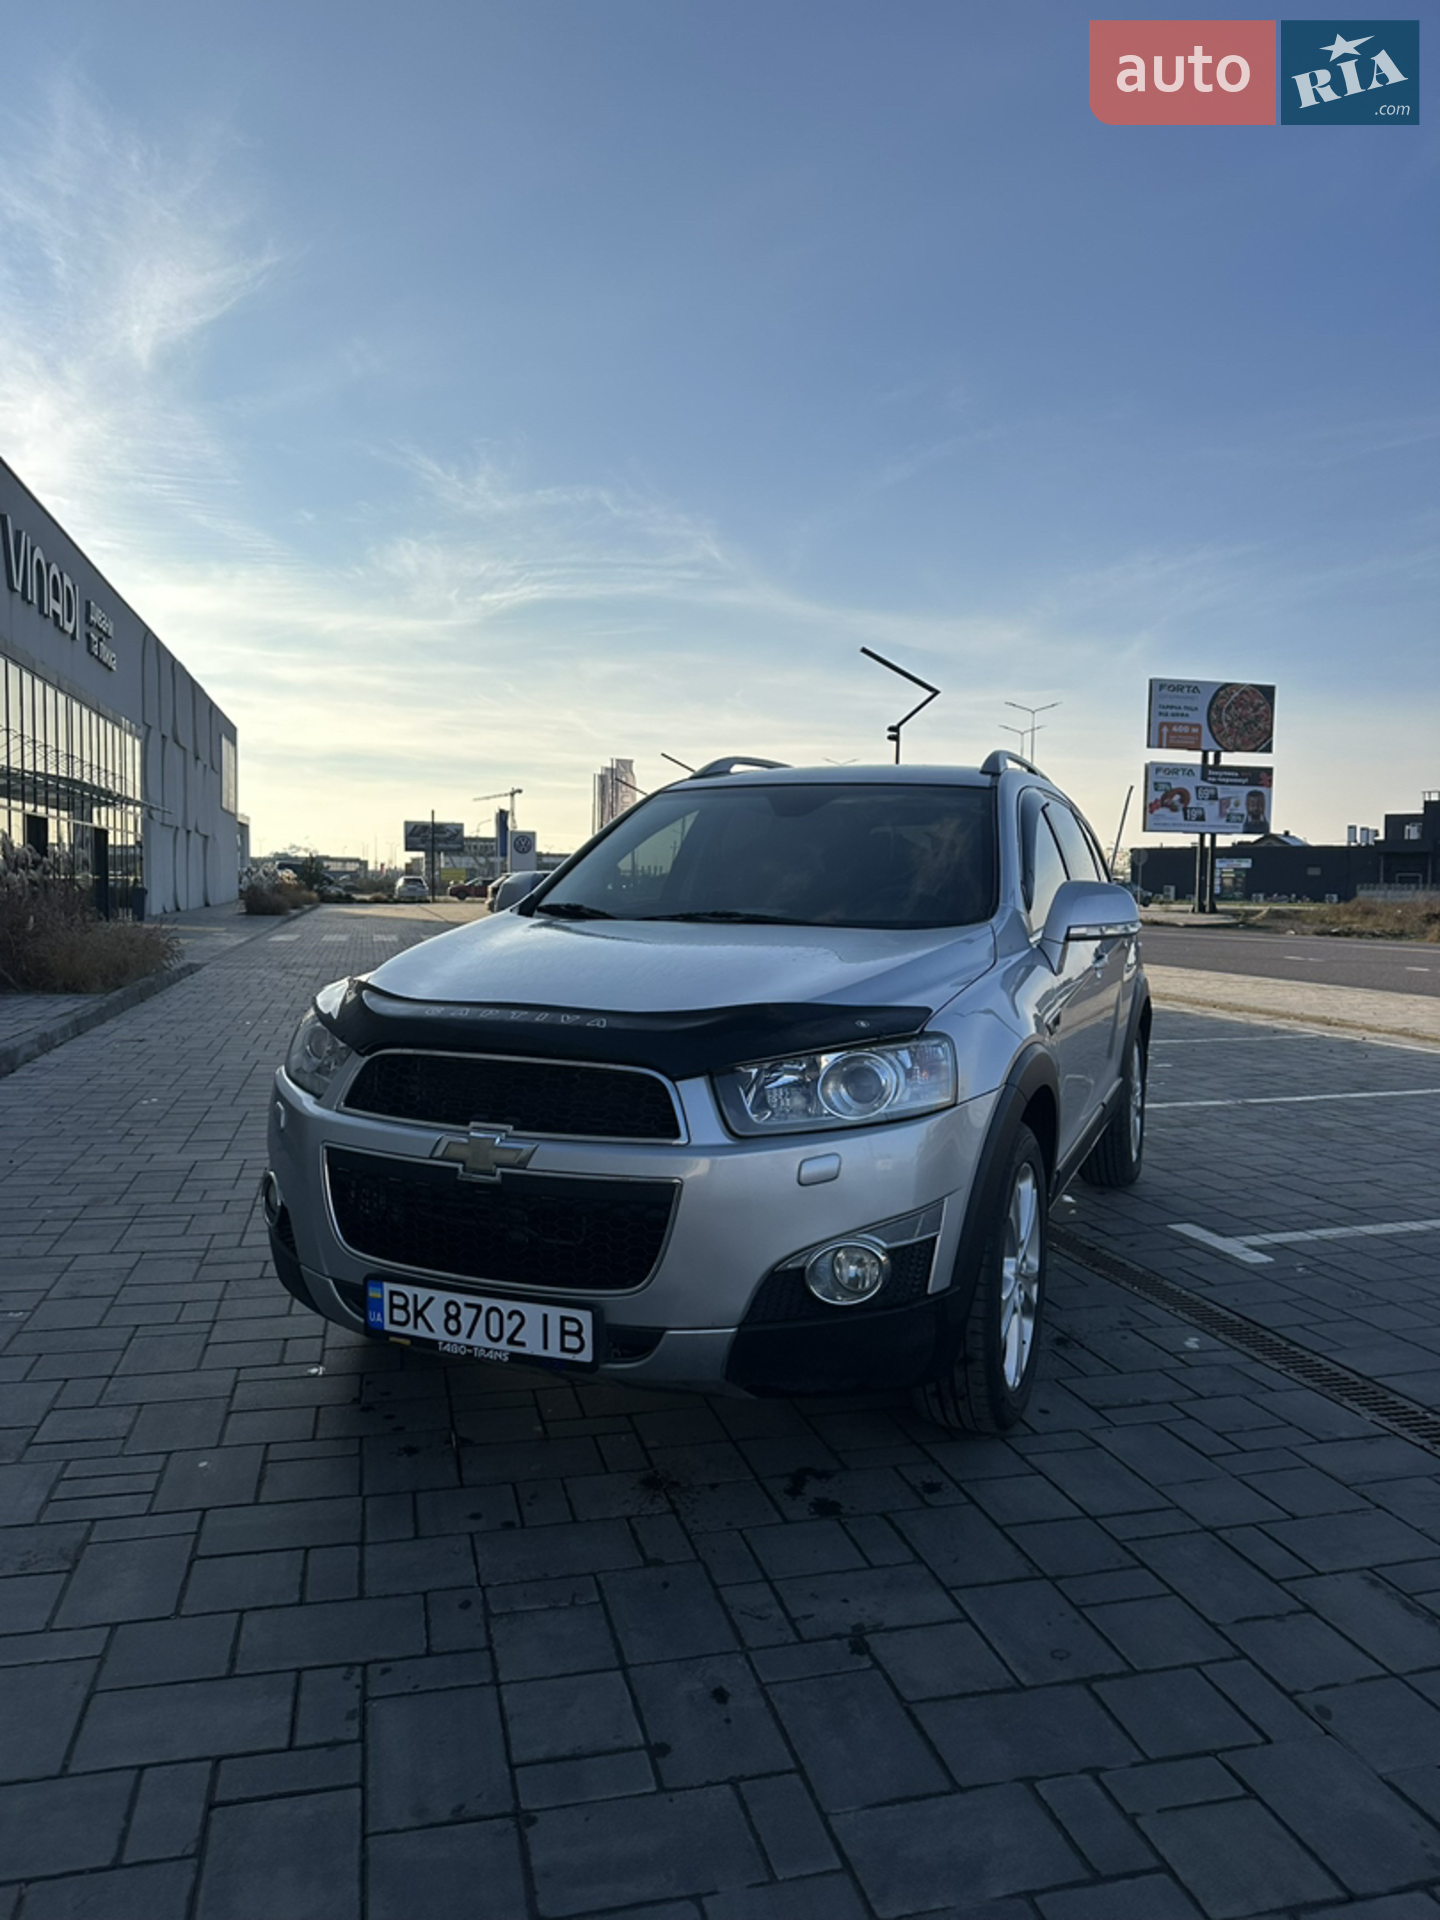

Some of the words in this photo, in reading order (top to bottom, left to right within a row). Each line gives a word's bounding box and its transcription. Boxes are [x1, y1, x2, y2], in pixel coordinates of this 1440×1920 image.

[6, 514, 80, 641] VINADI
[1158, 684, 1201, 694] FORTA
[1155, 767, 1195, 777] FORTA
[425, 1006, 607, 1028] CAPTIVA
[368, 1311, 383, 1324] UA
[388, 1289, 435, 1334] BK
[443, 1300, 526, 1348] 8702
[542, 1313, 586, 1355] IB
